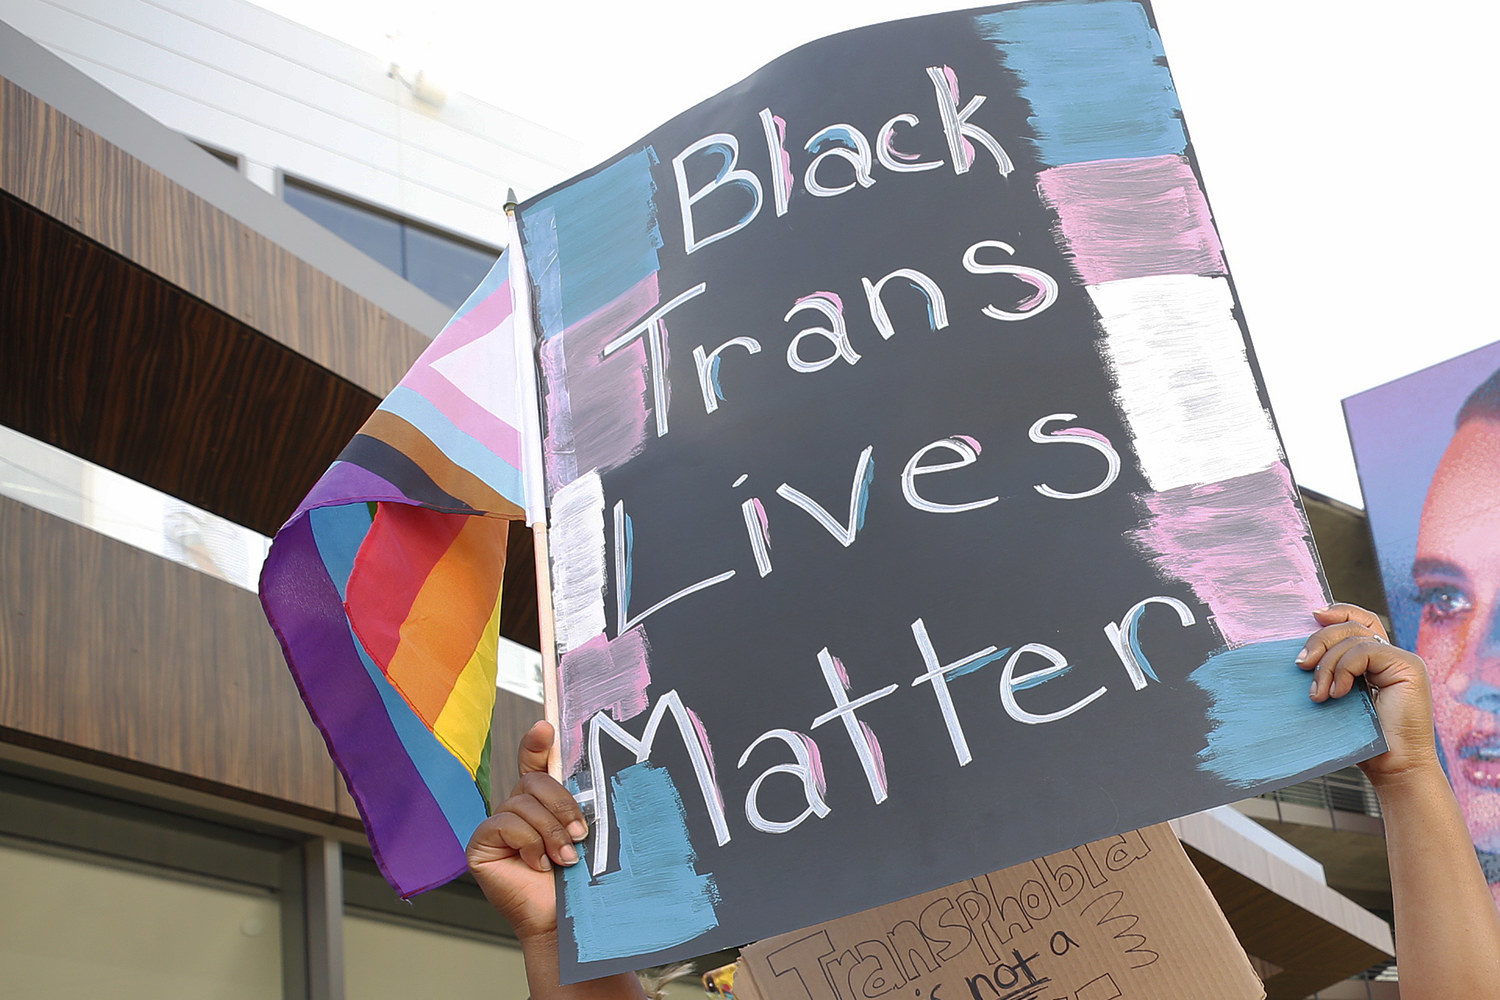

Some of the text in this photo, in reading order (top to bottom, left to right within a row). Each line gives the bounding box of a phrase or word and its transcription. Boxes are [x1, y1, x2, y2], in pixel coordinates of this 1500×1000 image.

[672, 64, 1015, 254] Black
[601, 239, 1059, 437] Trans
[612, 413, 1122, 635] Lives
[586, 596, 1196, 877] Matter
[1051, 930, 1080, 957] a
